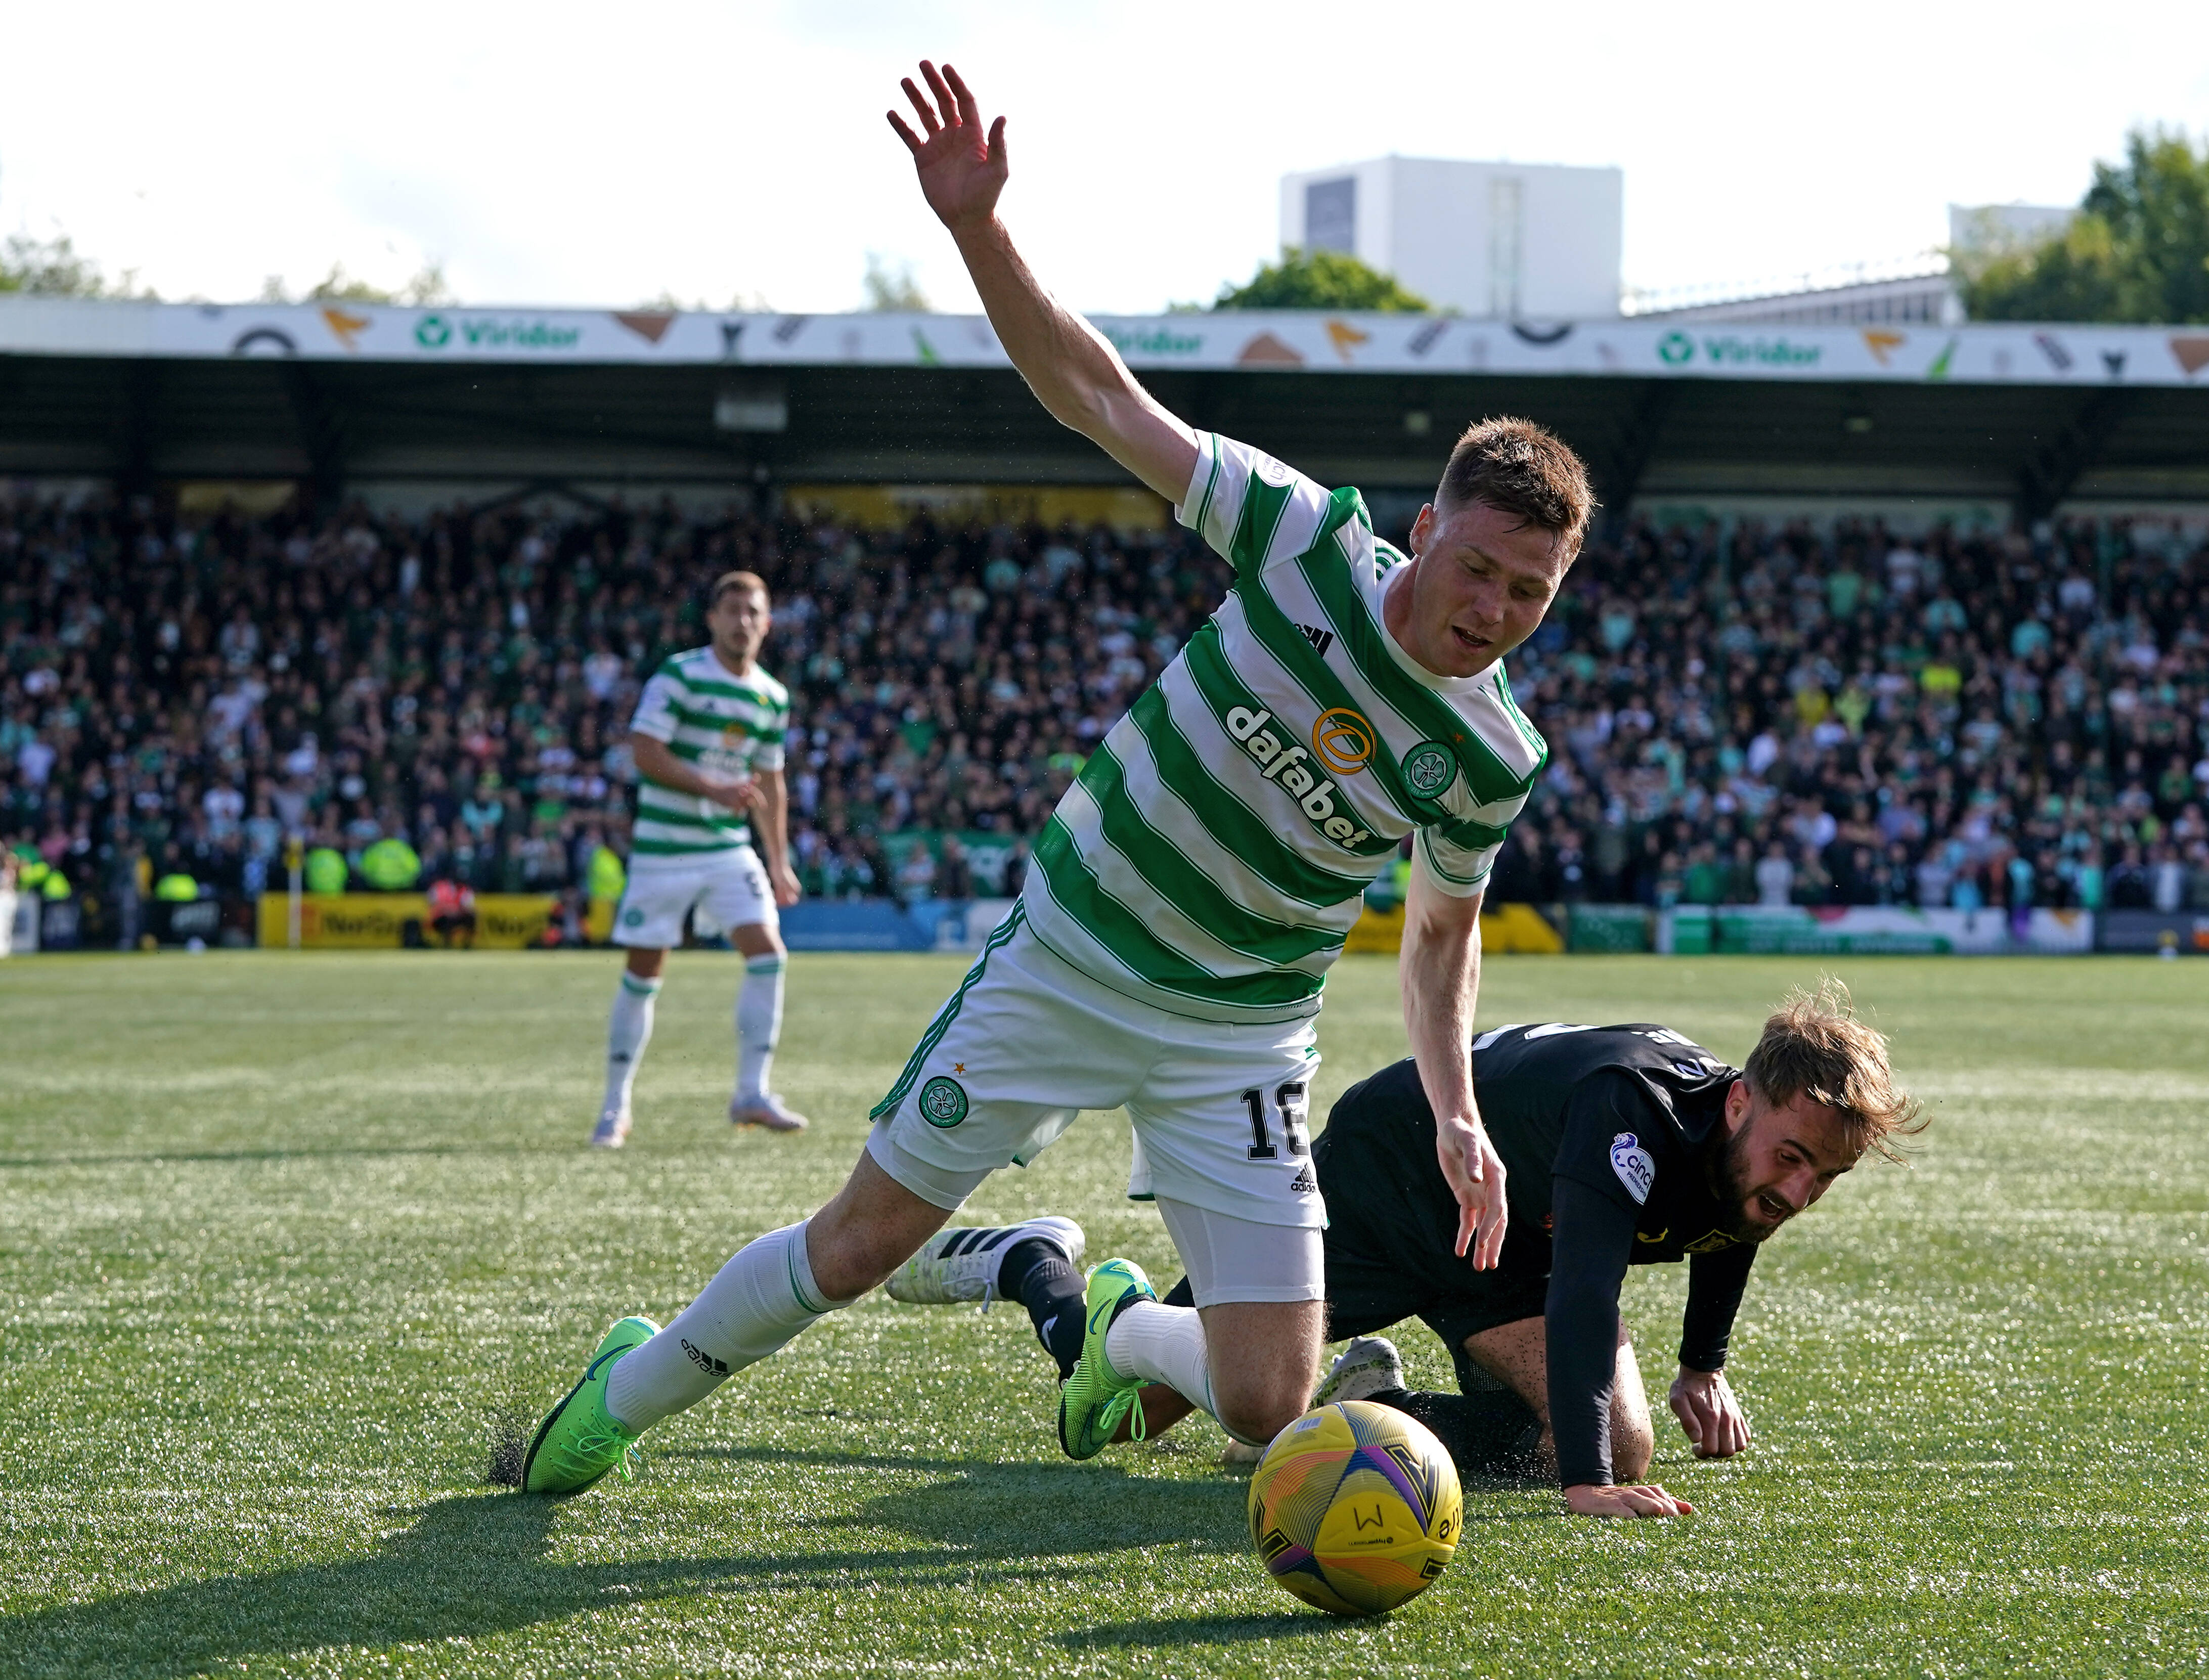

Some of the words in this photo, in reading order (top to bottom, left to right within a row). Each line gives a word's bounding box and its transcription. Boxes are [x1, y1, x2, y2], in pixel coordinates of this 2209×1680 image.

[460, 319, 583, 346] Viridor
[1102, 324, 1206, 352] iridor
[1702, 334, 1822, 365] Viridor
[1226, 705, 1371, 849] dafabet
[1290, 1181, 1316, 1193] adida
[681, 1338, 733, 1377] adidas
